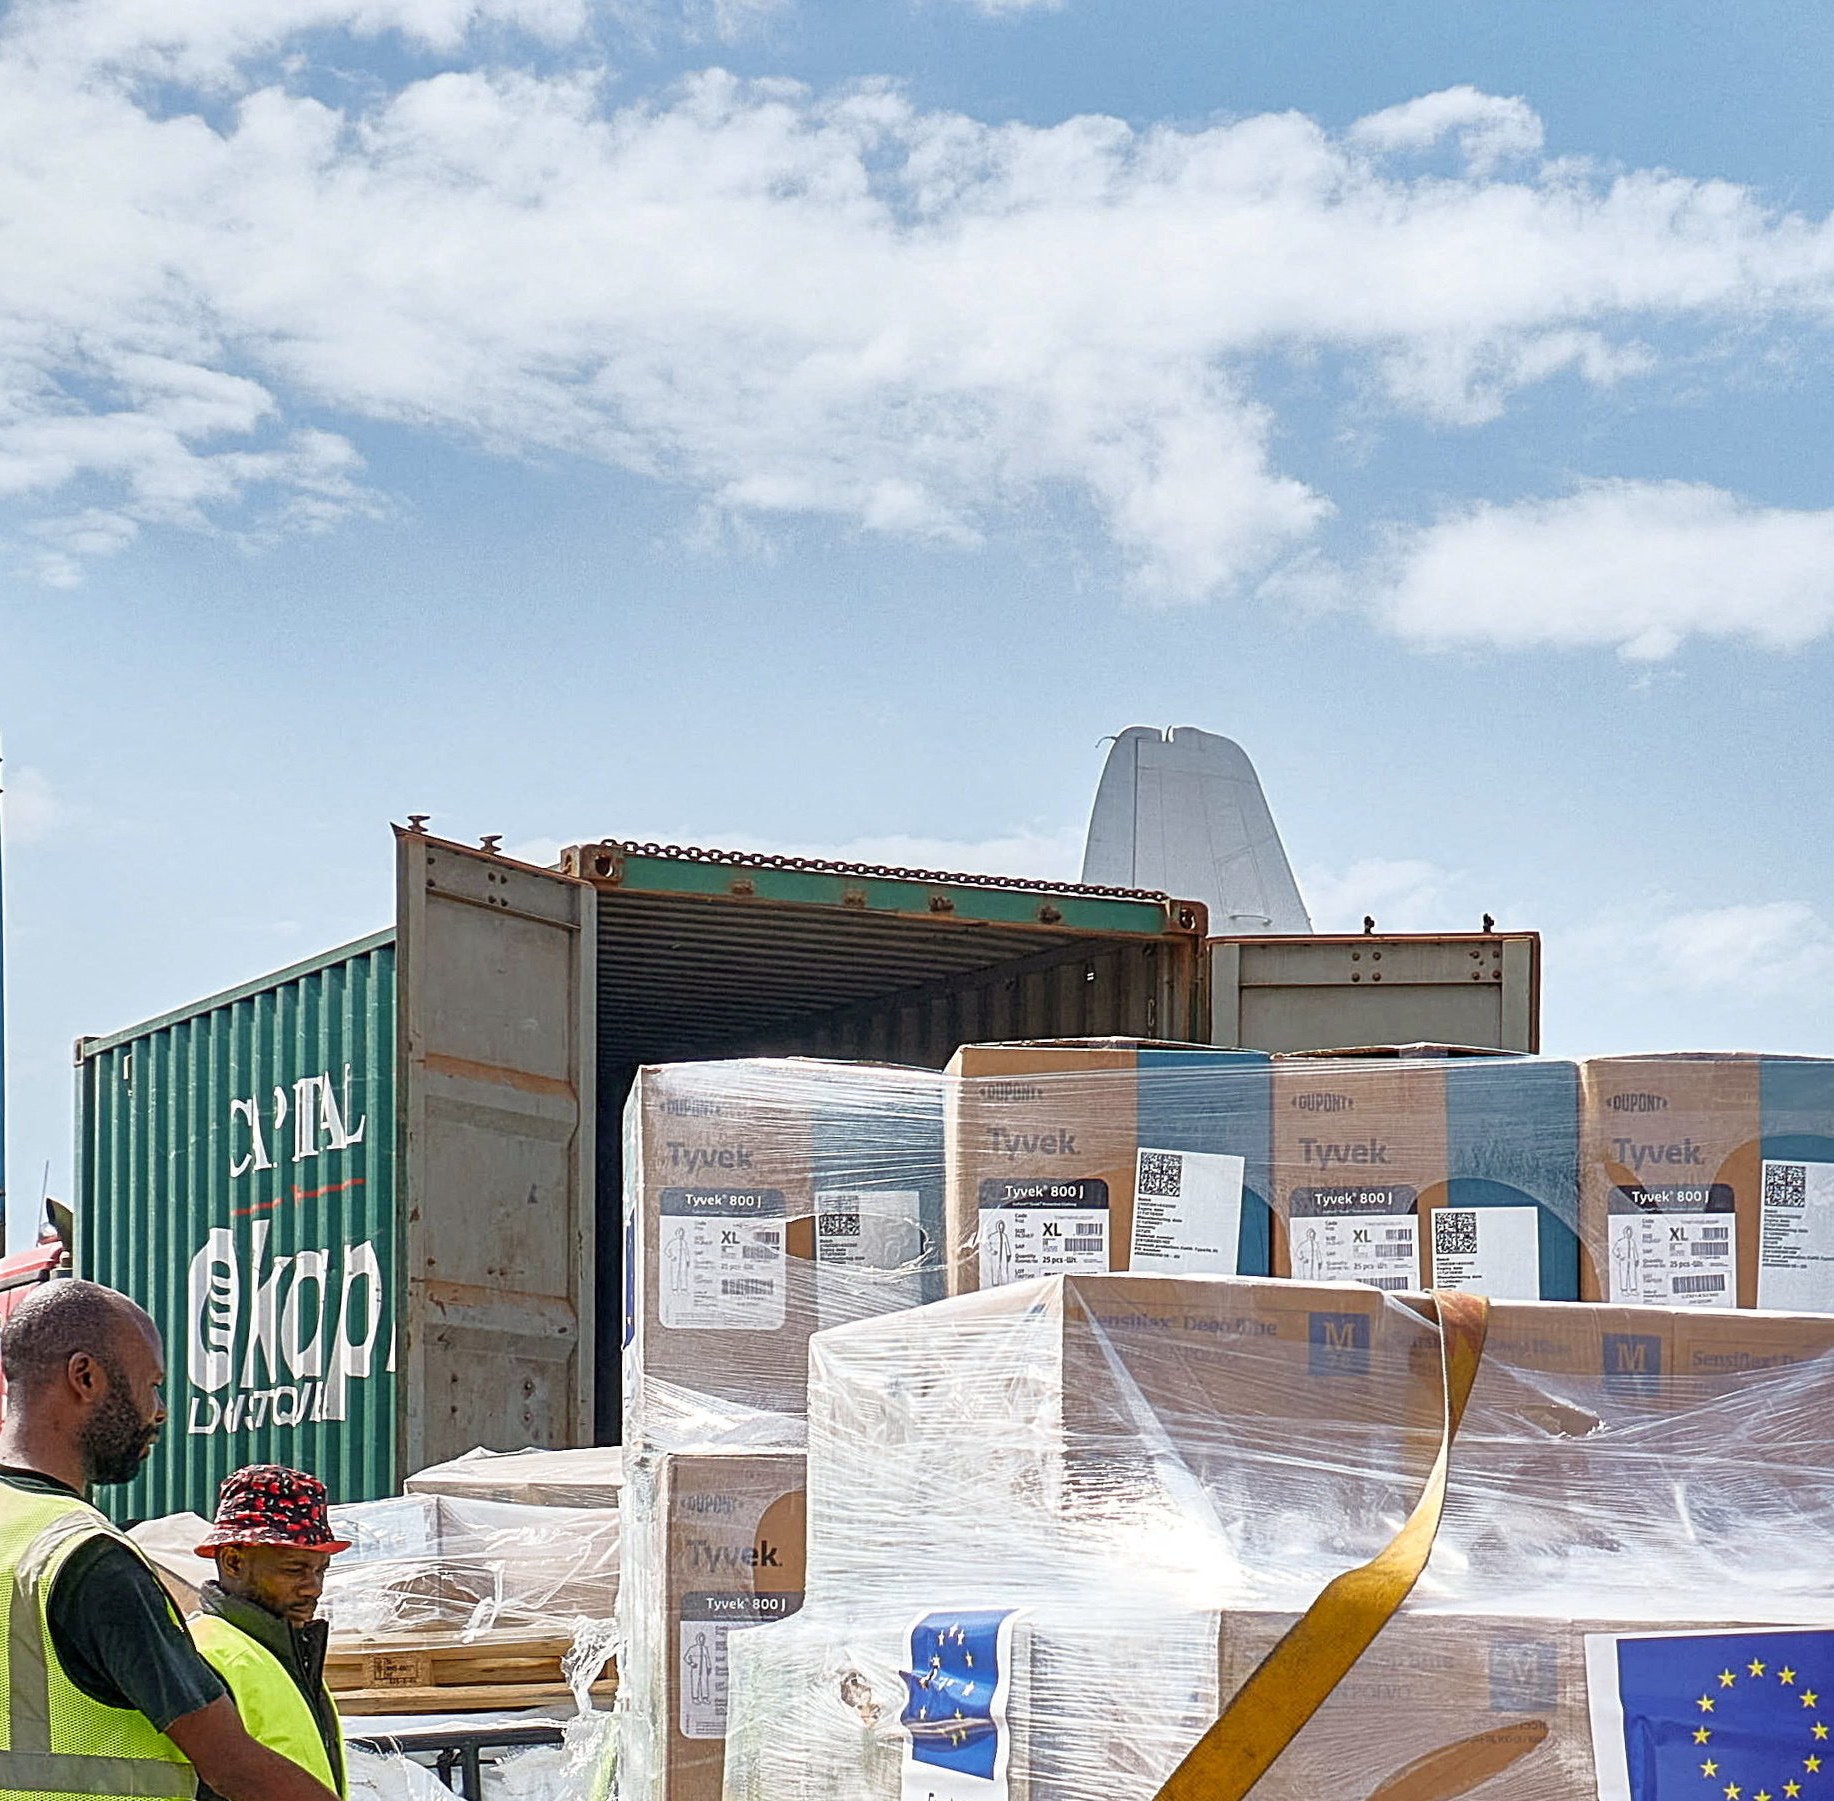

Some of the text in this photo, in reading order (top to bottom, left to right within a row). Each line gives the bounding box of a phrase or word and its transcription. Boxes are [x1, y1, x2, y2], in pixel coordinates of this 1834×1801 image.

[1299, 1093, 1349, 1112] DUPONT
[1613, 1094, 1663, 1112] DUPONT
[1299, 1138, 1388, 1170] Tyvek
[1613, 1138, 1701, 1170] Tyvek
[1051, 1186, 1077, 1197] 800
[1677, 1191, 1702, 1201] 800
[730, 1196, 754, 1206] 800
[1360, 1193, 1385, 1204] 800
[1042, 1223, 1062, 1236] XL
[1353, 1230, 1372, 1242] XL
[1670, 1227, 1688, 1241] XL
[721, 1231, 740, 1244] XL
[1324, 1322, 1356, 1350] M
[1618, 1343, 1647, 1372] M
[688, 1540, 778, 1572] Tyvek
[753, 1598, 778, 1609] 800
